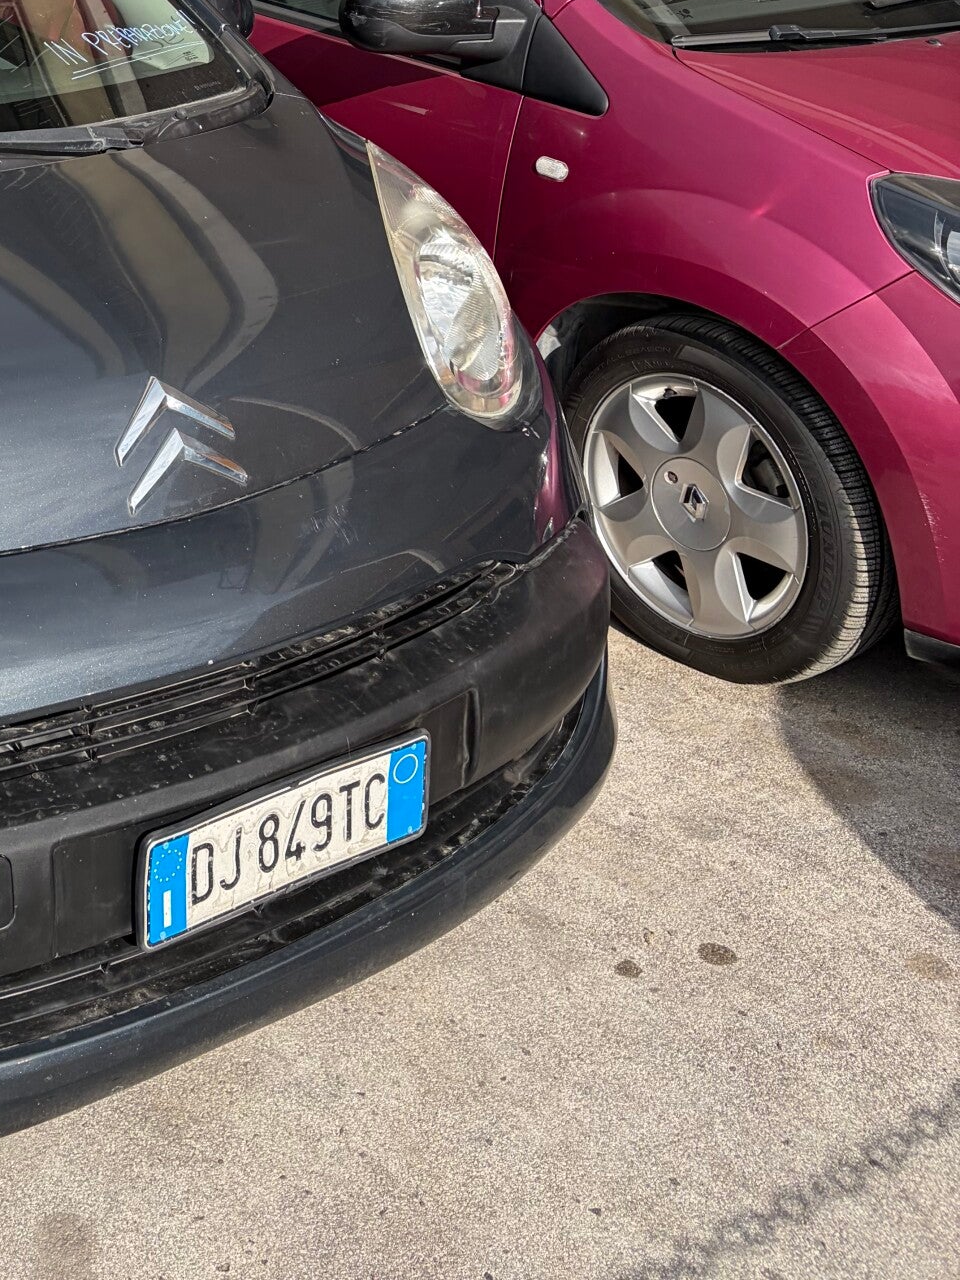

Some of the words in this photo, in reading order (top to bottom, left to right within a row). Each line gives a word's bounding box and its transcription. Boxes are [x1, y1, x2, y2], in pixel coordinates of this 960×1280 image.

[43, 38, 88, 66] IN
[191, 826, 243, 907] DJ
[258, 773, 387, 874] 849TC
